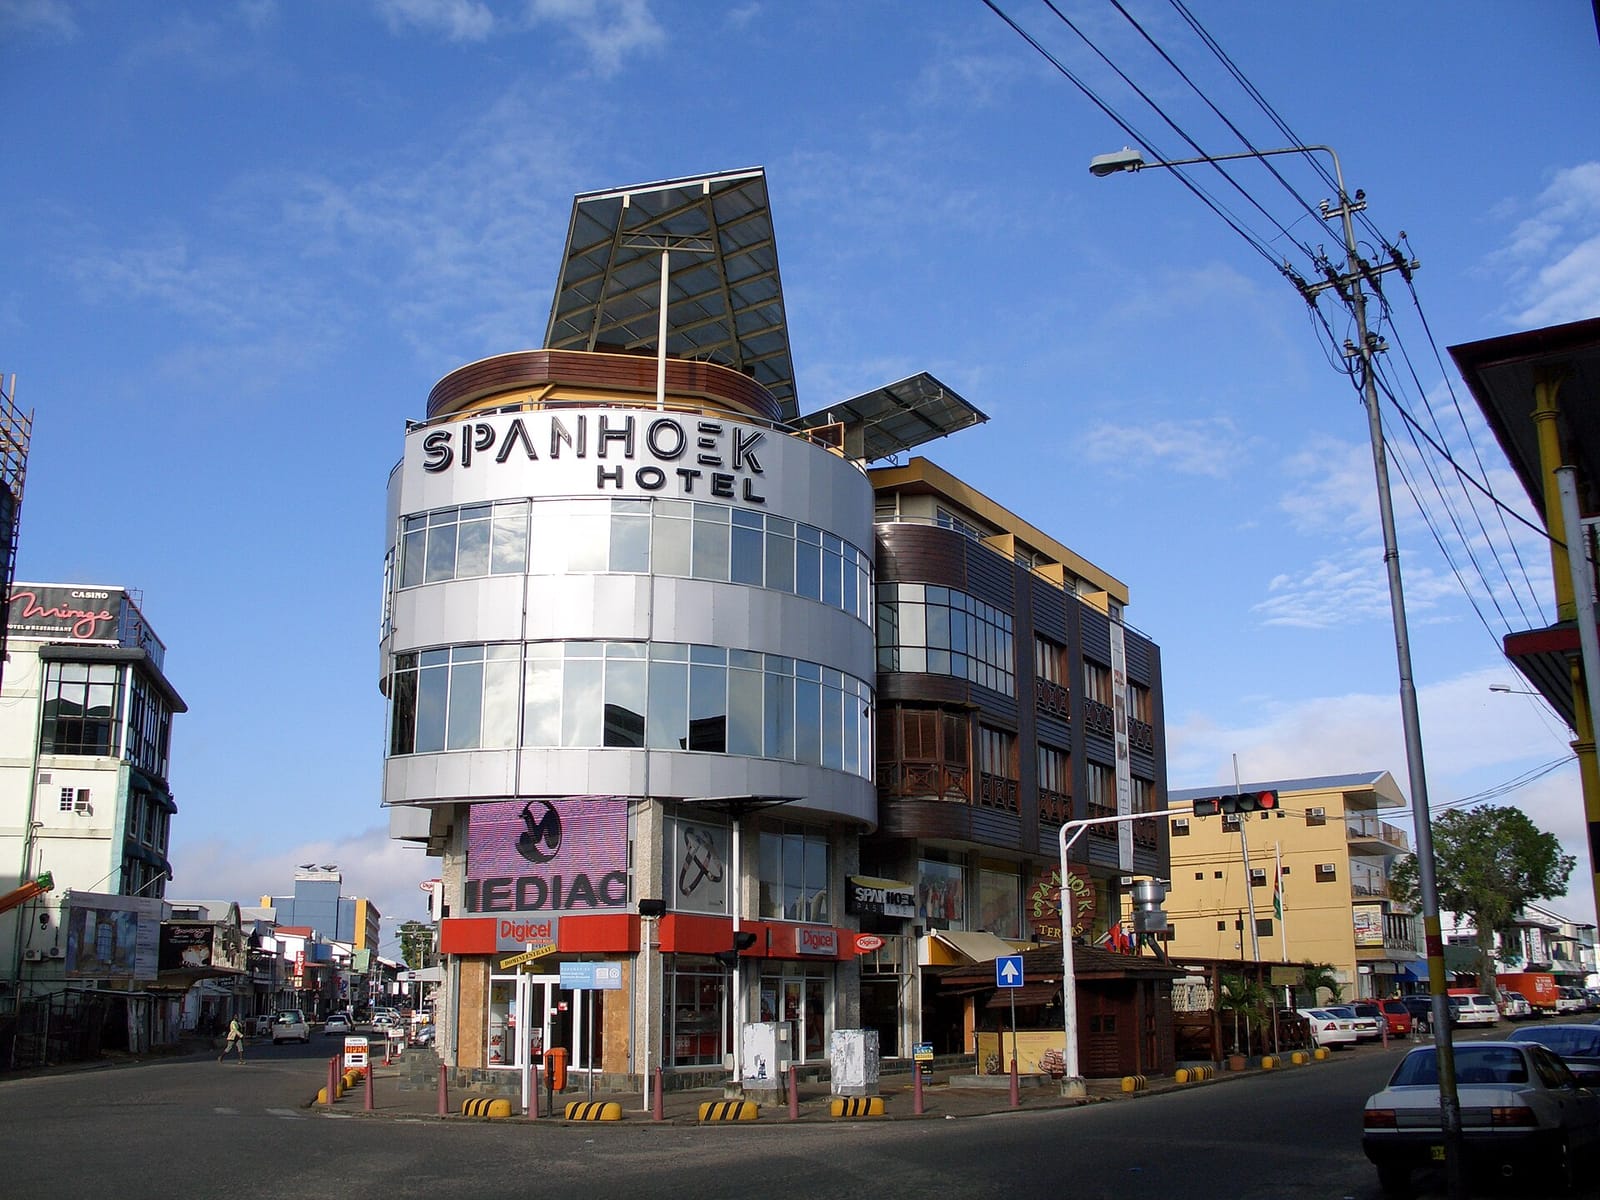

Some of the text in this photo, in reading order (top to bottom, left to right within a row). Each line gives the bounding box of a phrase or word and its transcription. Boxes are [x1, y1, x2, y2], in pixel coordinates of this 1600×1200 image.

[423, 413, 766, 474] SPANHOEK
[597, 464, 766, 503] HOTEL
[71, 591, 109, 600] CASINO
[467, 870, 627, 912] EDIAC
[501, 919, 552, 943] Digicel
[803, 930, 834, 950] Digicel
[1039, 922, 1084, 938] TERAS
[345, 1045, 368, 1054] OPEN
